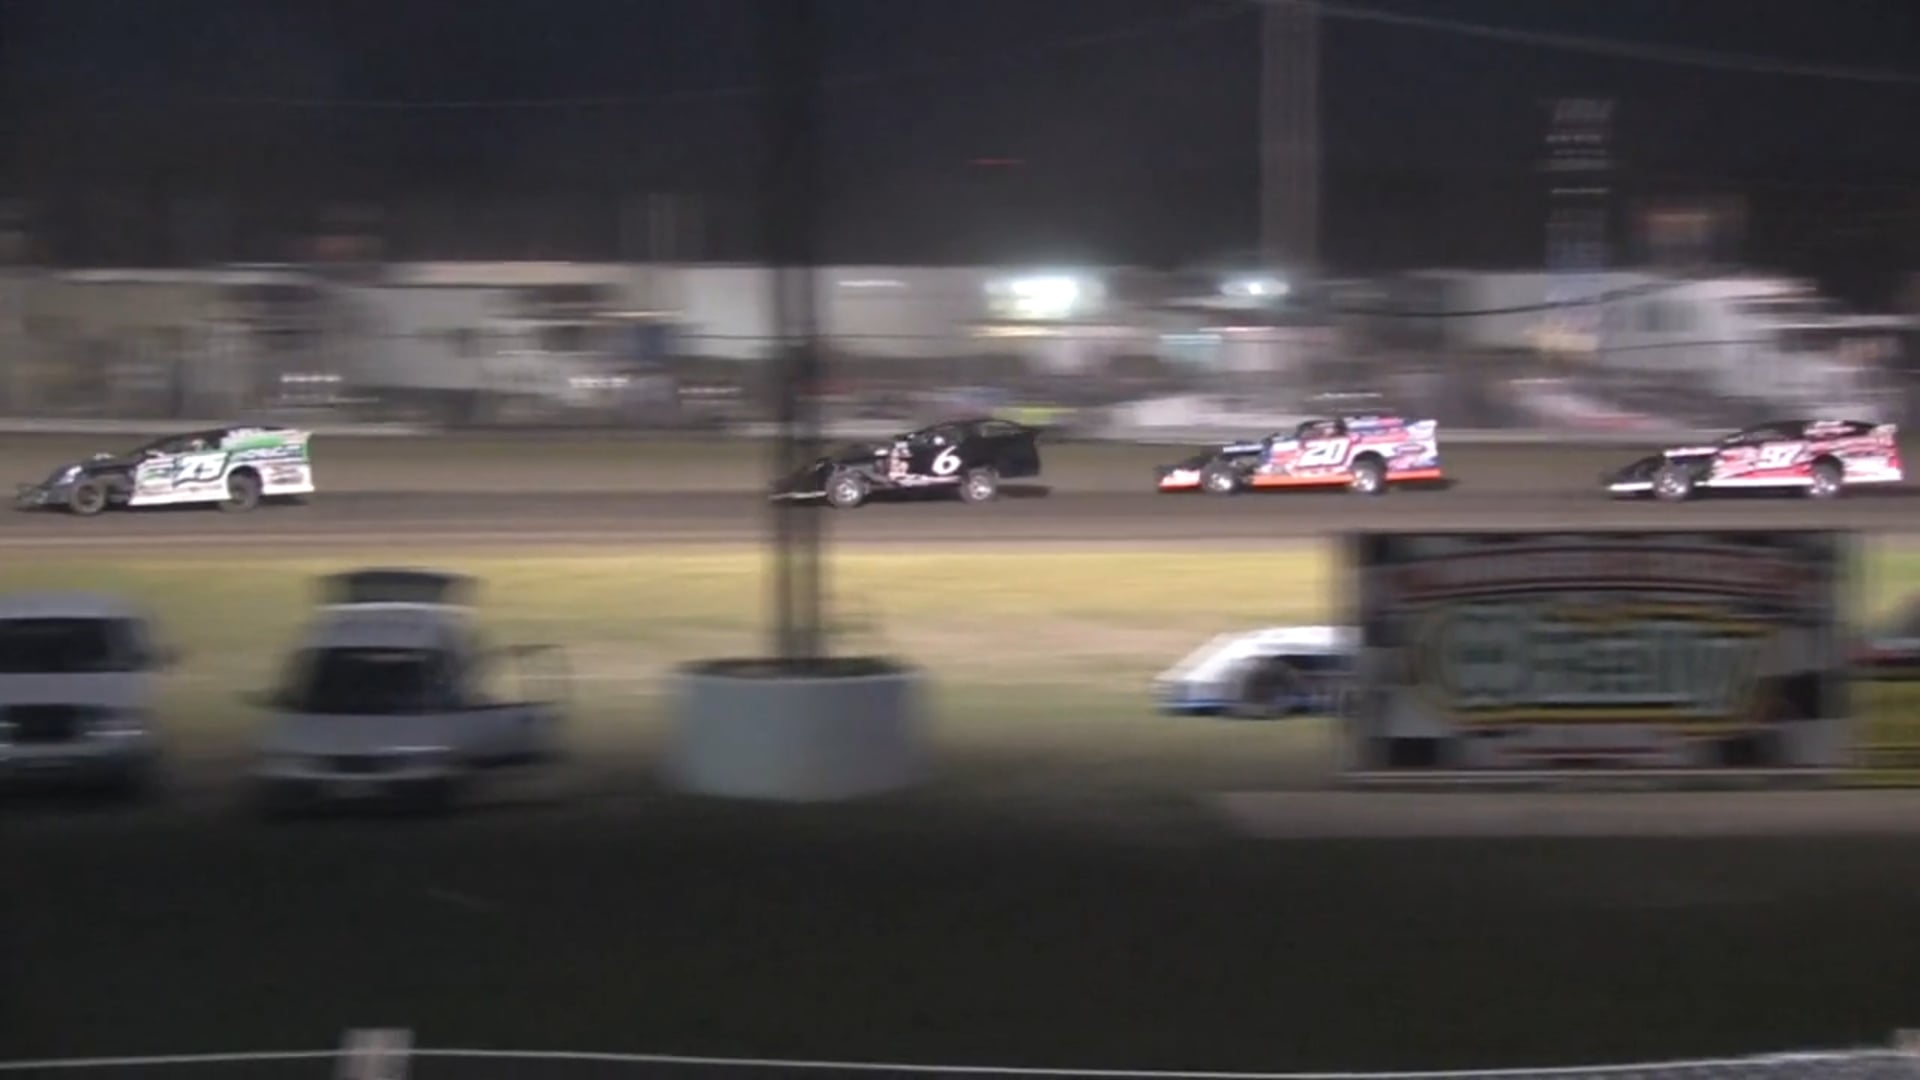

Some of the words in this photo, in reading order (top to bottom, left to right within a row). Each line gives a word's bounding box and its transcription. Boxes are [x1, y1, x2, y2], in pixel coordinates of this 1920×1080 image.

[932, 445, 962, 475] 6
[1297, 438, 1347, 466] 20
[1757, 443, 1802, 468] 97
